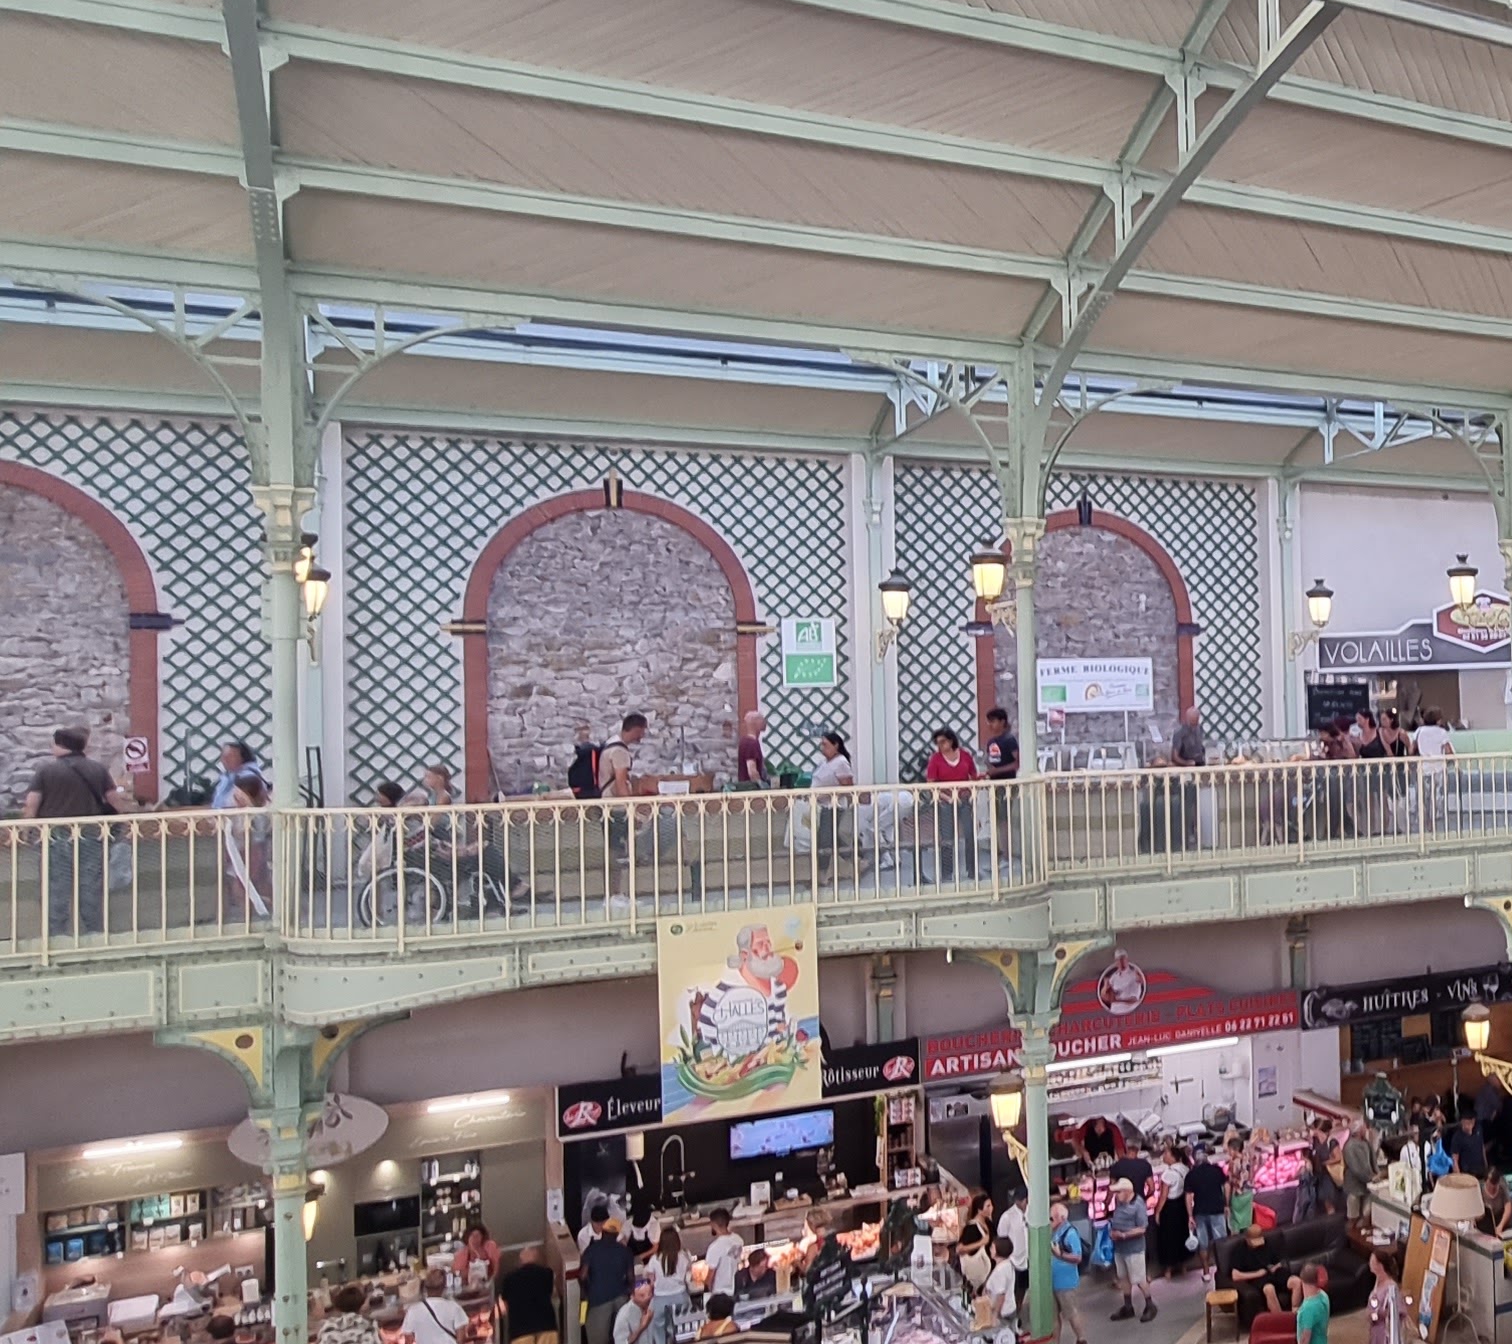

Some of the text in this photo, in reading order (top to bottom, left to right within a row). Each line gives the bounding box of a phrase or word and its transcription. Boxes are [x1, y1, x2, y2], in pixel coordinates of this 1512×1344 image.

[1324, 637, 1433, 665] VOLAILLES
[1040, 663, 1149, 677] FERME BIOLOGIQUE
[1363, 977, 1479, 1013] HUÎTRES VINS
[931, 1048, 1020, 1076] ARTISAN
[1049, 1033, 1122, 1063] OUCHER
[607, 1096, 661, 1121] Éleveur
